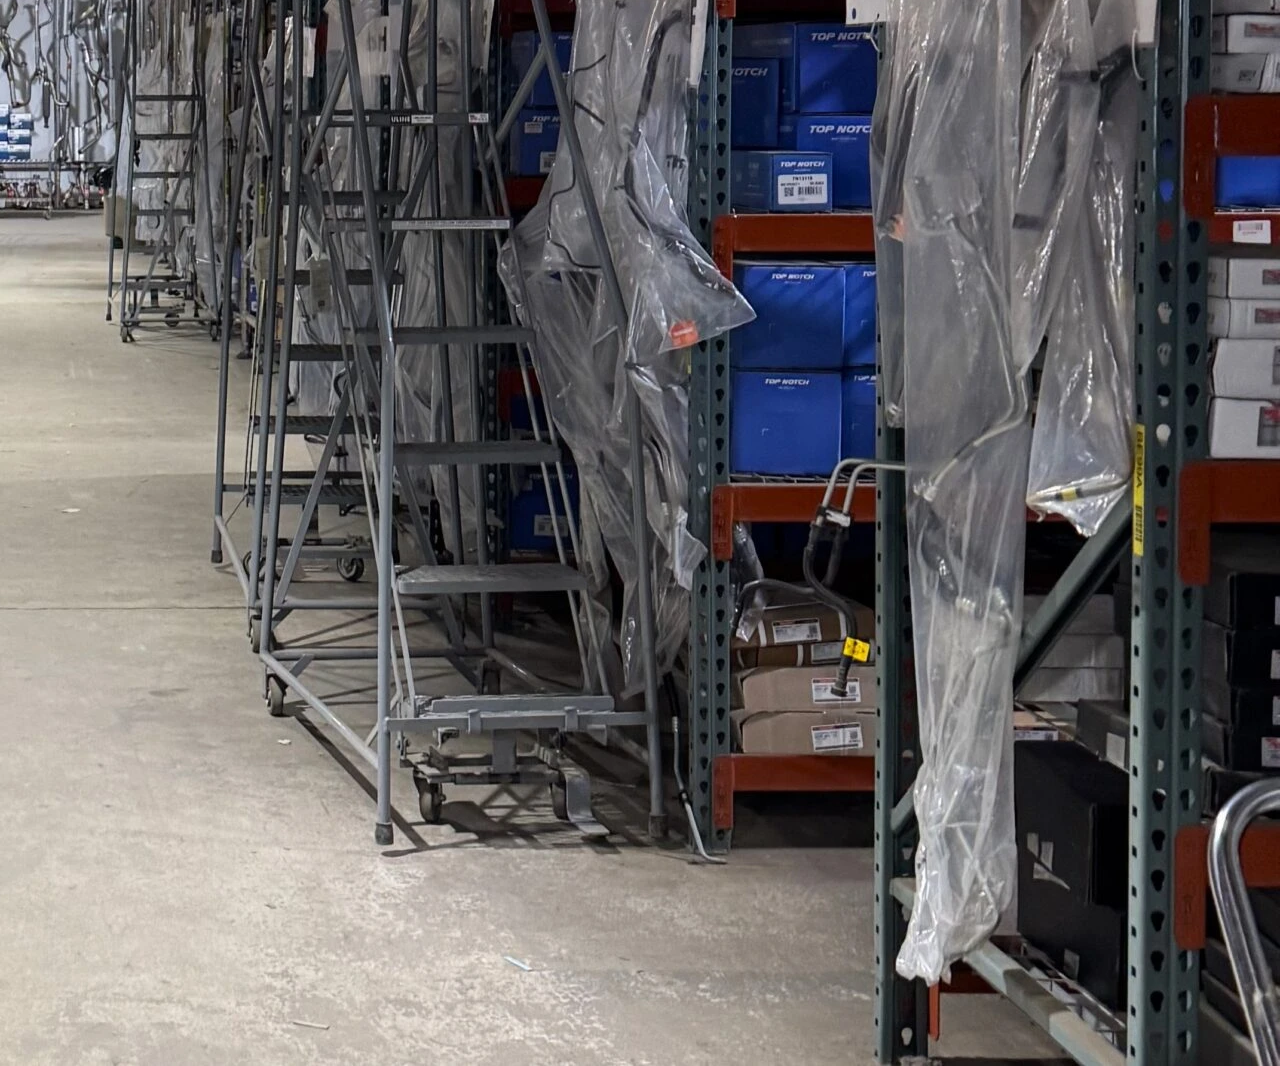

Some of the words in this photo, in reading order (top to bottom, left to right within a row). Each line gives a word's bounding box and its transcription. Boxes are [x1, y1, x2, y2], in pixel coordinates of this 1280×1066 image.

[811, 32, 835, 41] TOP
[809, 124, 835, 134] TOP
[836, 124, 872, 134] NOTC
